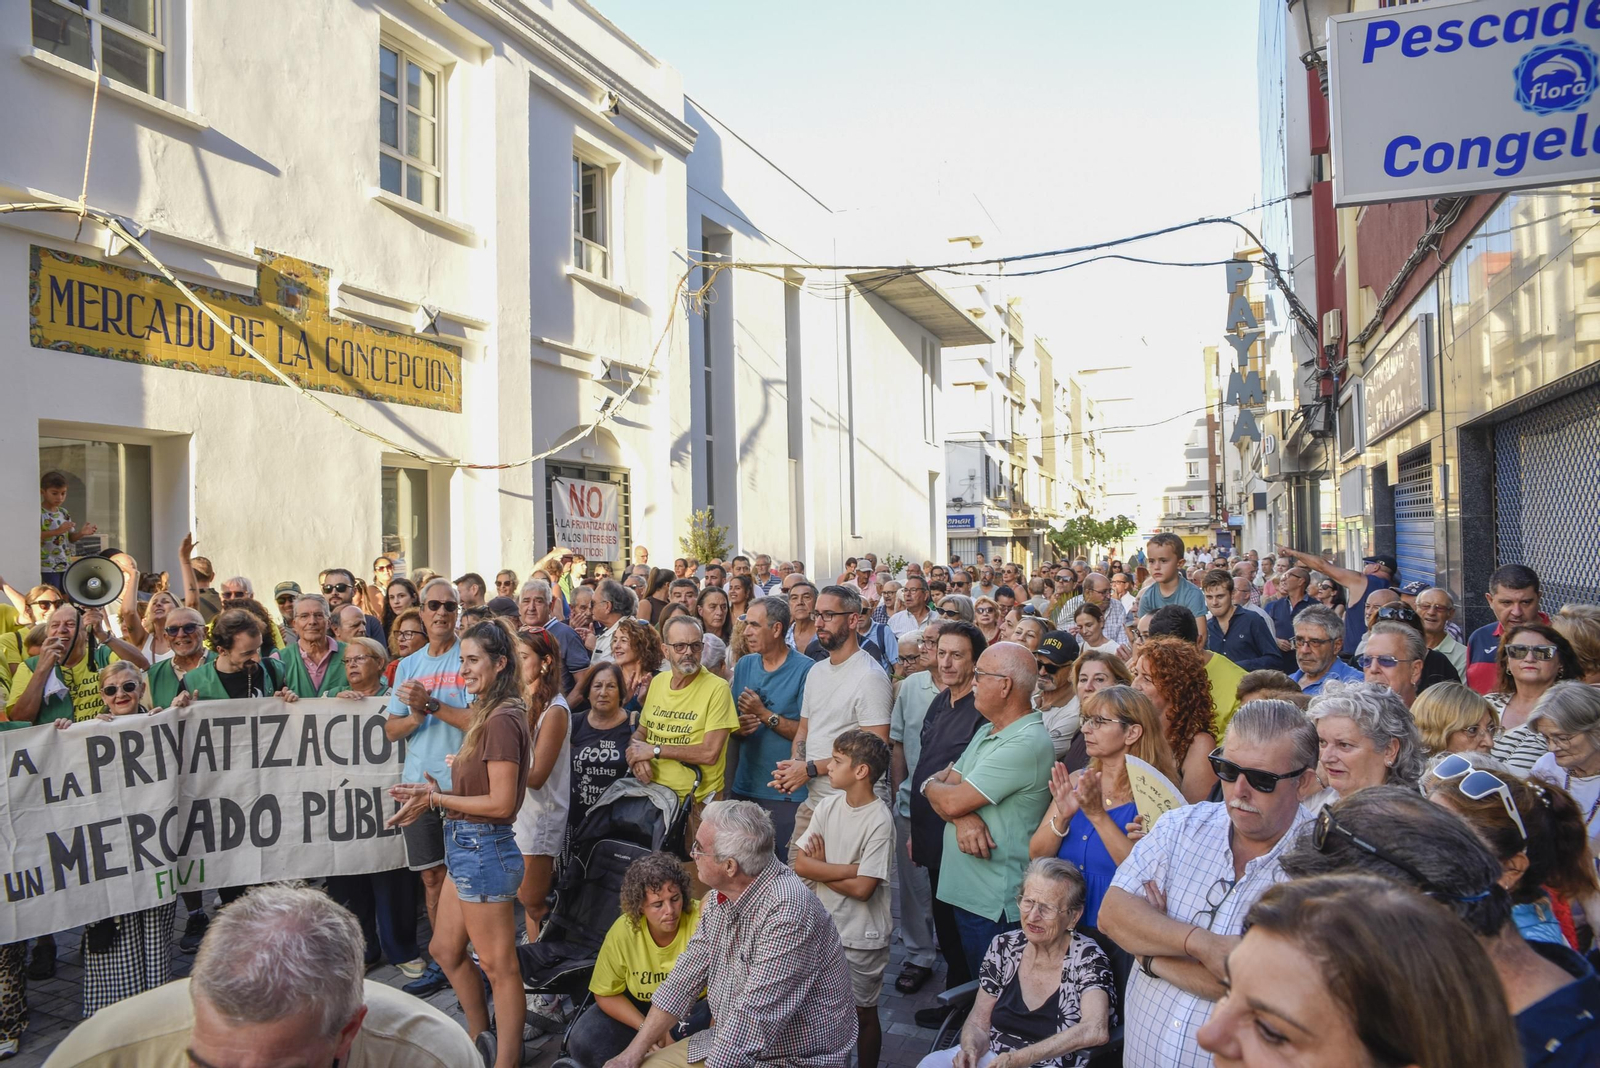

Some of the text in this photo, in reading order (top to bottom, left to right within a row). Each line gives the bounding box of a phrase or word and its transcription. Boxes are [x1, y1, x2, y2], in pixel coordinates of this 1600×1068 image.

[1530, 82, 1587, 106] flora
[1384, 113, 1600, 178] Congel
[49, 274, 456, 395] MERCADO DE LA CONCEPCION
[1224, 263, 1265, 443] PAYMA
[1375, 384, 1405, 434] FLORA
[569, 483, 603, 519] NO
[561, 518, 570, 529] LA
[561, 532, 567, 542] A
[568, 533, 581, 543] LOS
[582, 534, 617, 545] INTERESES
[656, 723, 666, 731] se
[667, 724, 693, 734] vende
[579, 746, 620, 762] GOOD
[600, 740, 616, 749] THE
[9, 748, 39, 778] A
[43, 772, 85, 804] LA
[585, 766, 617, 777] thing
[4, 866, 44, 902] UN
[46, 794, 282, 892] MERCADO
